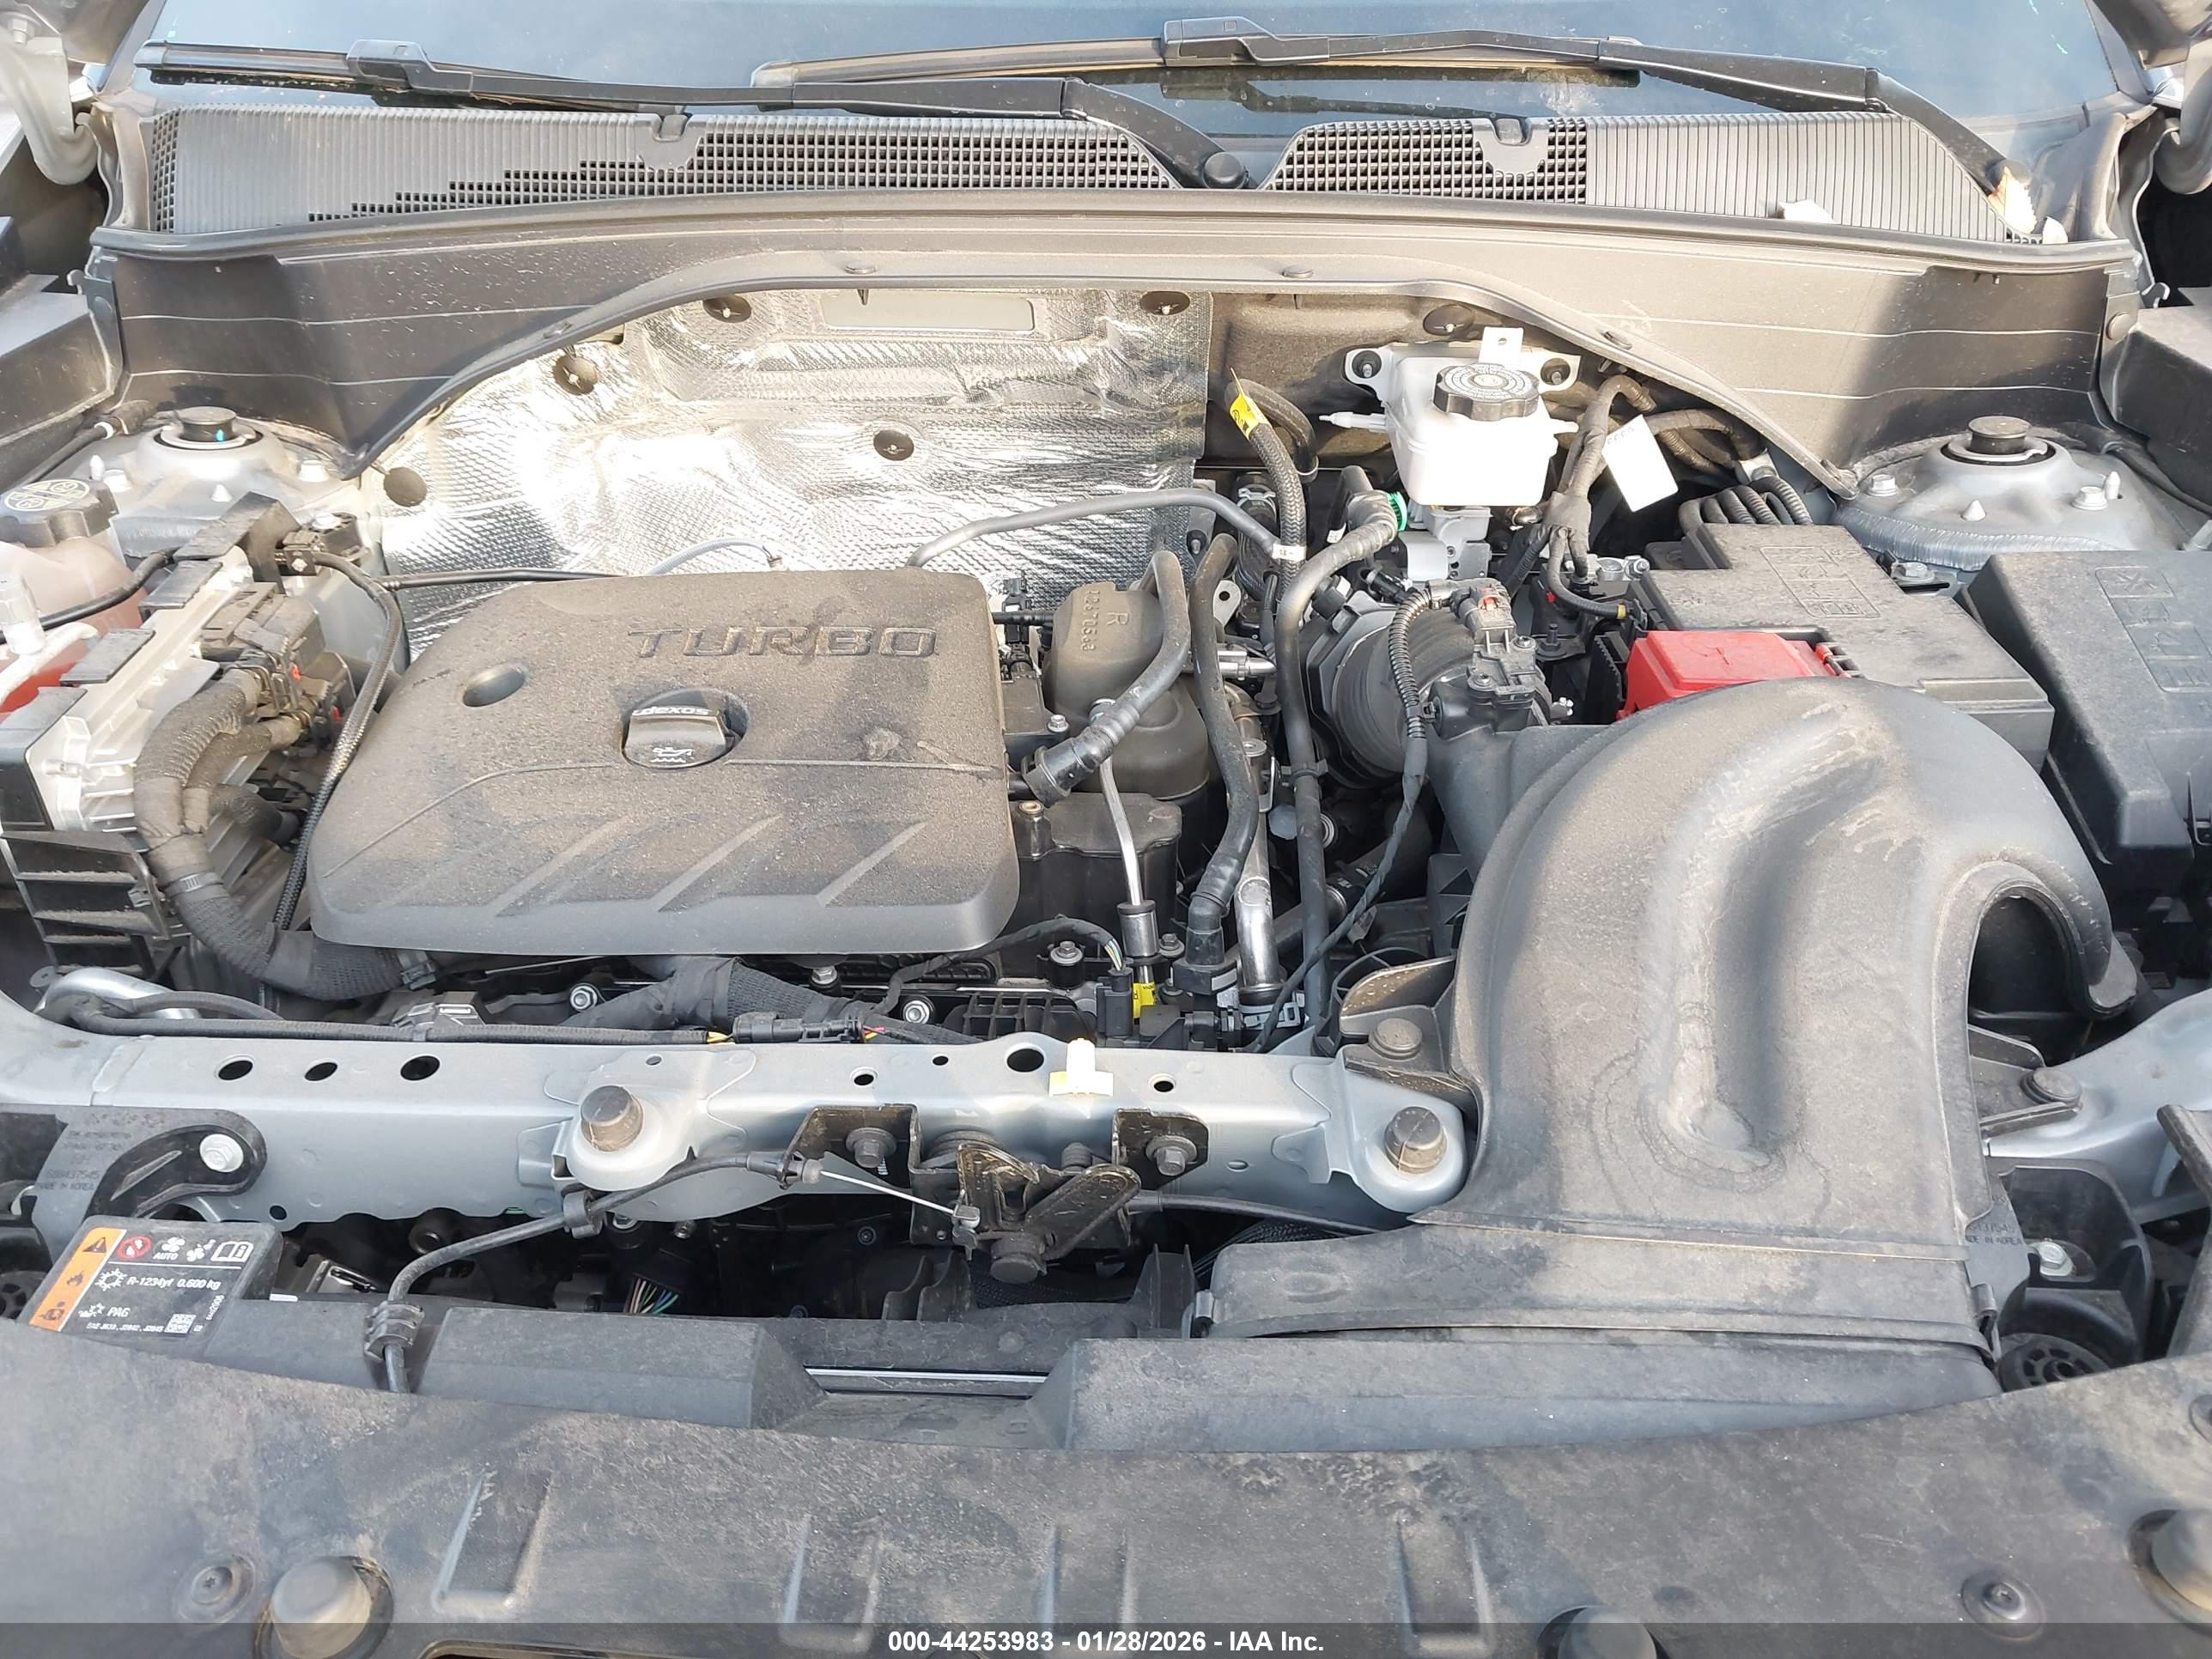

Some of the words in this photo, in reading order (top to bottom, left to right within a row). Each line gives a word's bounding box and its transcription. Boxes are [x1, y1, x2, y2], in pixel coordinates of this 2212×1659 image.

[628, 626, 939, 658] TURBO
[1996, 1236, 2023, 1245] KOREA
[153, 1252, 179, 1261] AUTO
[126, 1277, 174, 1289] R-1234yf
[177, 1279, 205, 1289] 0.600
[205, 1279, 222, 1291] kg
[106, 1306, 131, 1318] PAG
